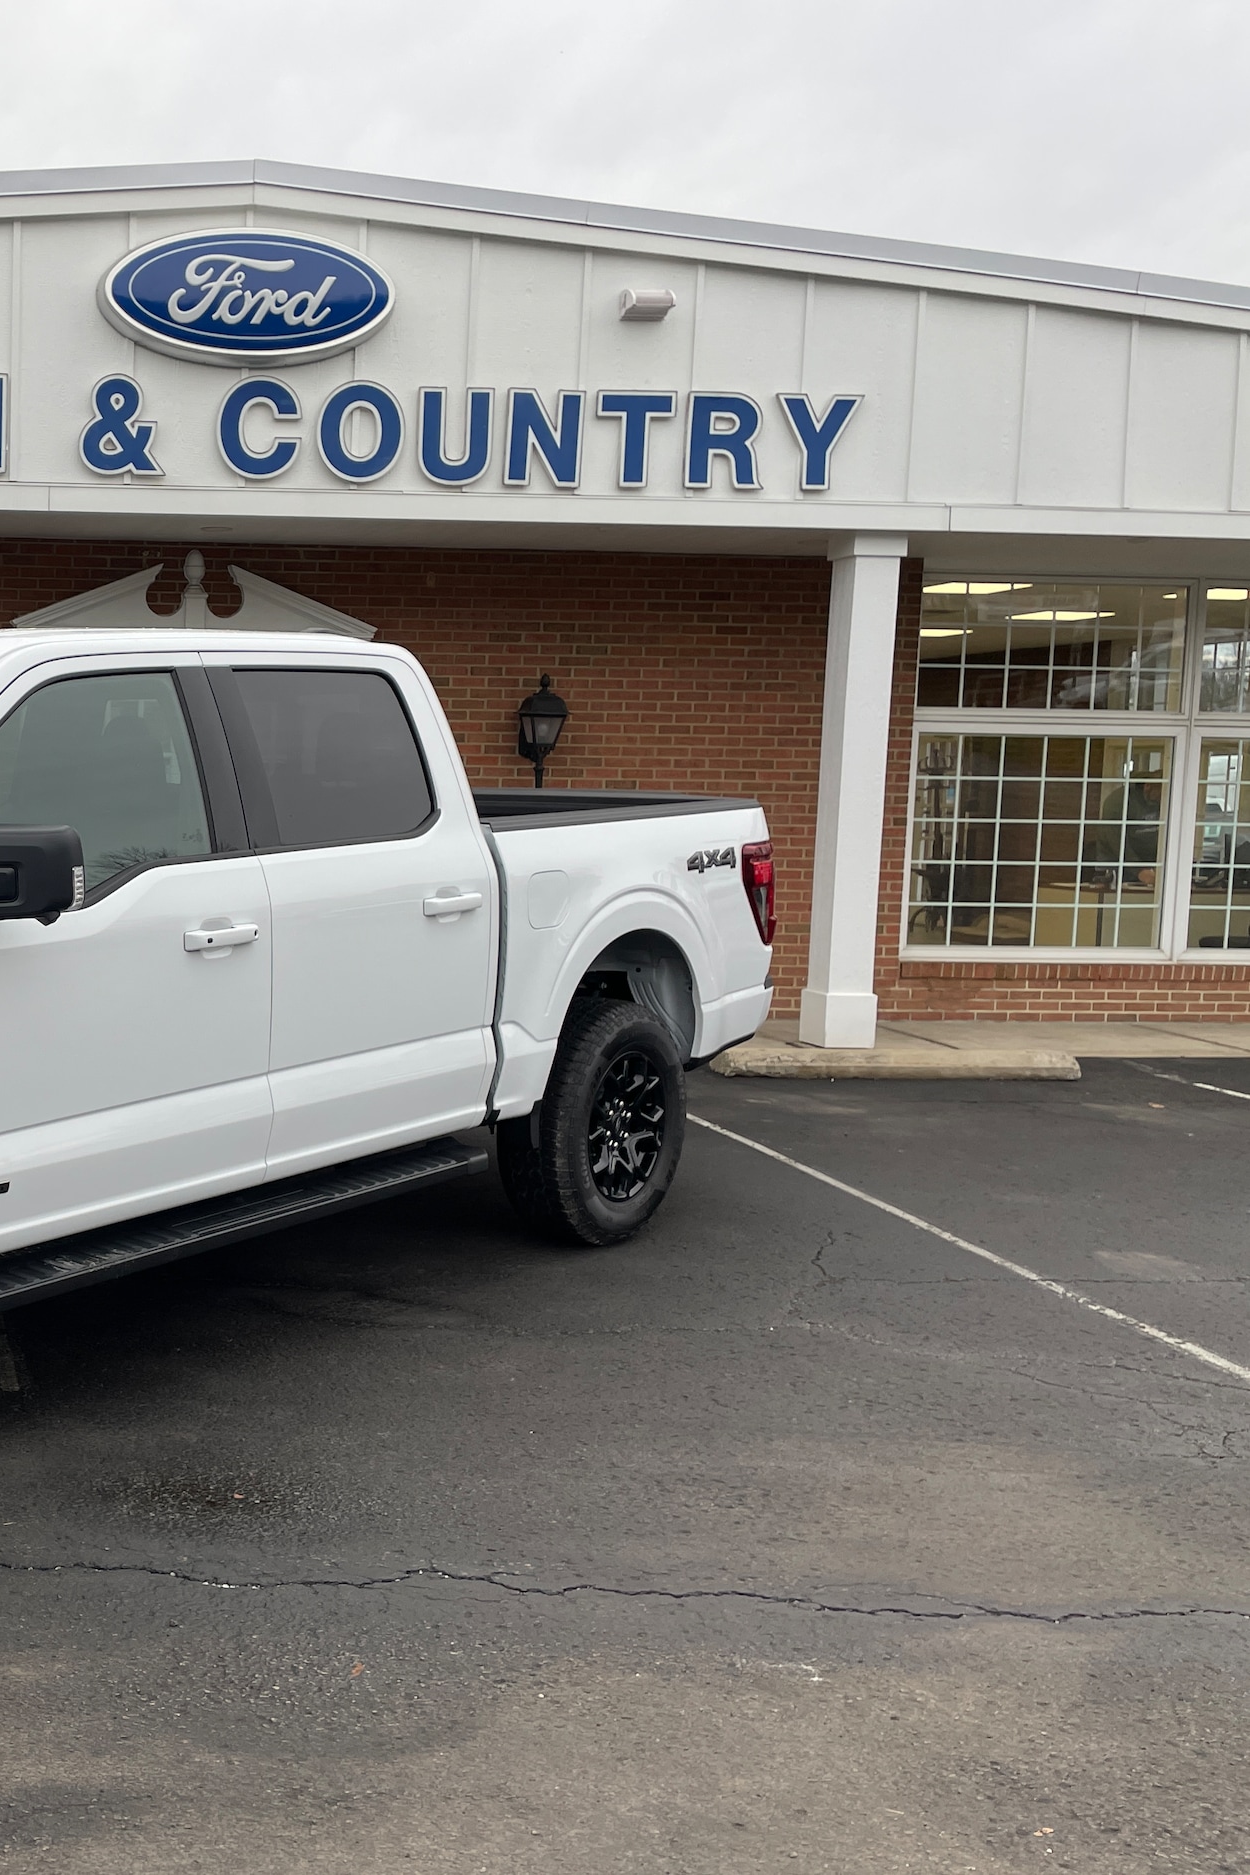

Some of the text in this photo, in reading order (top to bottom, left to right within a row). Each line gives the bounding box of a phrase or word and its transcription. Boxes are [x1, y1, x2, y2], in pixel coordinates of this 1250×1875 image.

[168, 254, 337, 327] Ford
[79, 373, 166, 476] &
[217, 375, 865, 491] COUNTRY
